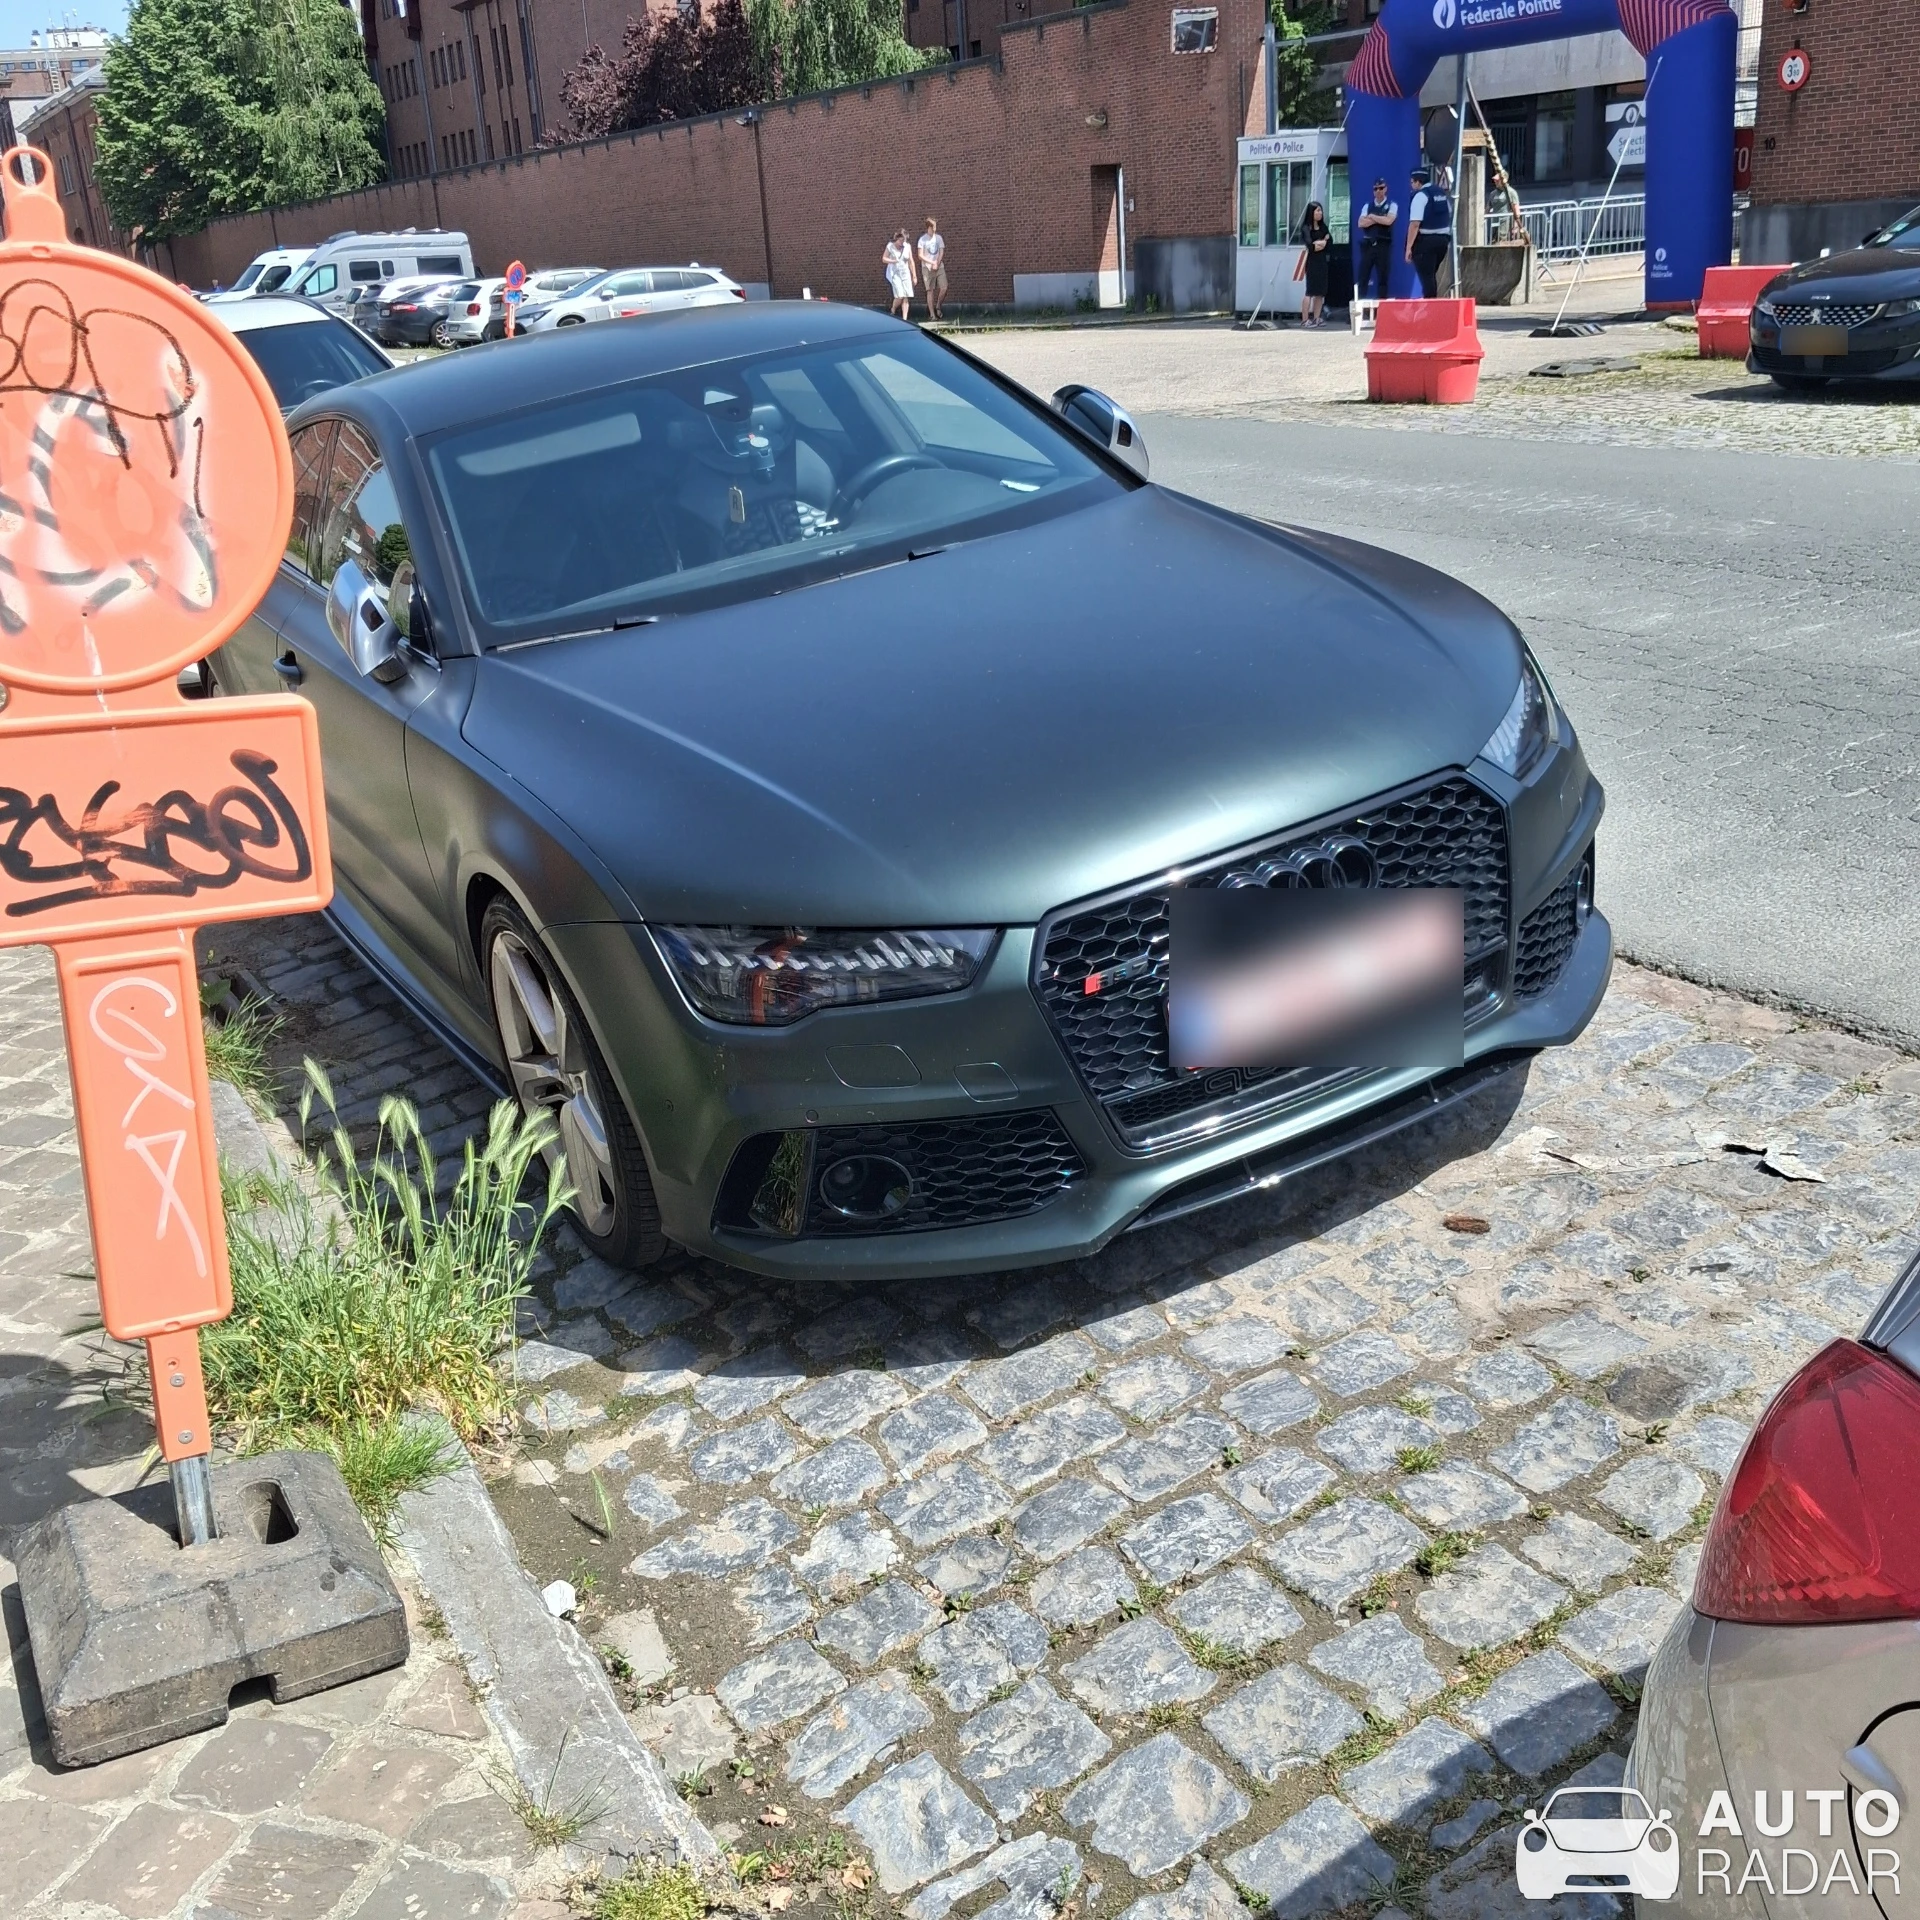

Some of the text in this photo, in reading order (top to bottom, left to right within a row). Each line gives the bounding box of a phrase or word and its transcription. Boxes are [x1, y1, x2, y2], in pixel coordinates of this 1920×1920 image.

[1460, 0, 1563, 26] Federale Politie
[1249, 141, 1304, 155] Politie Police
[1764, 137, 1776, 150] 10
